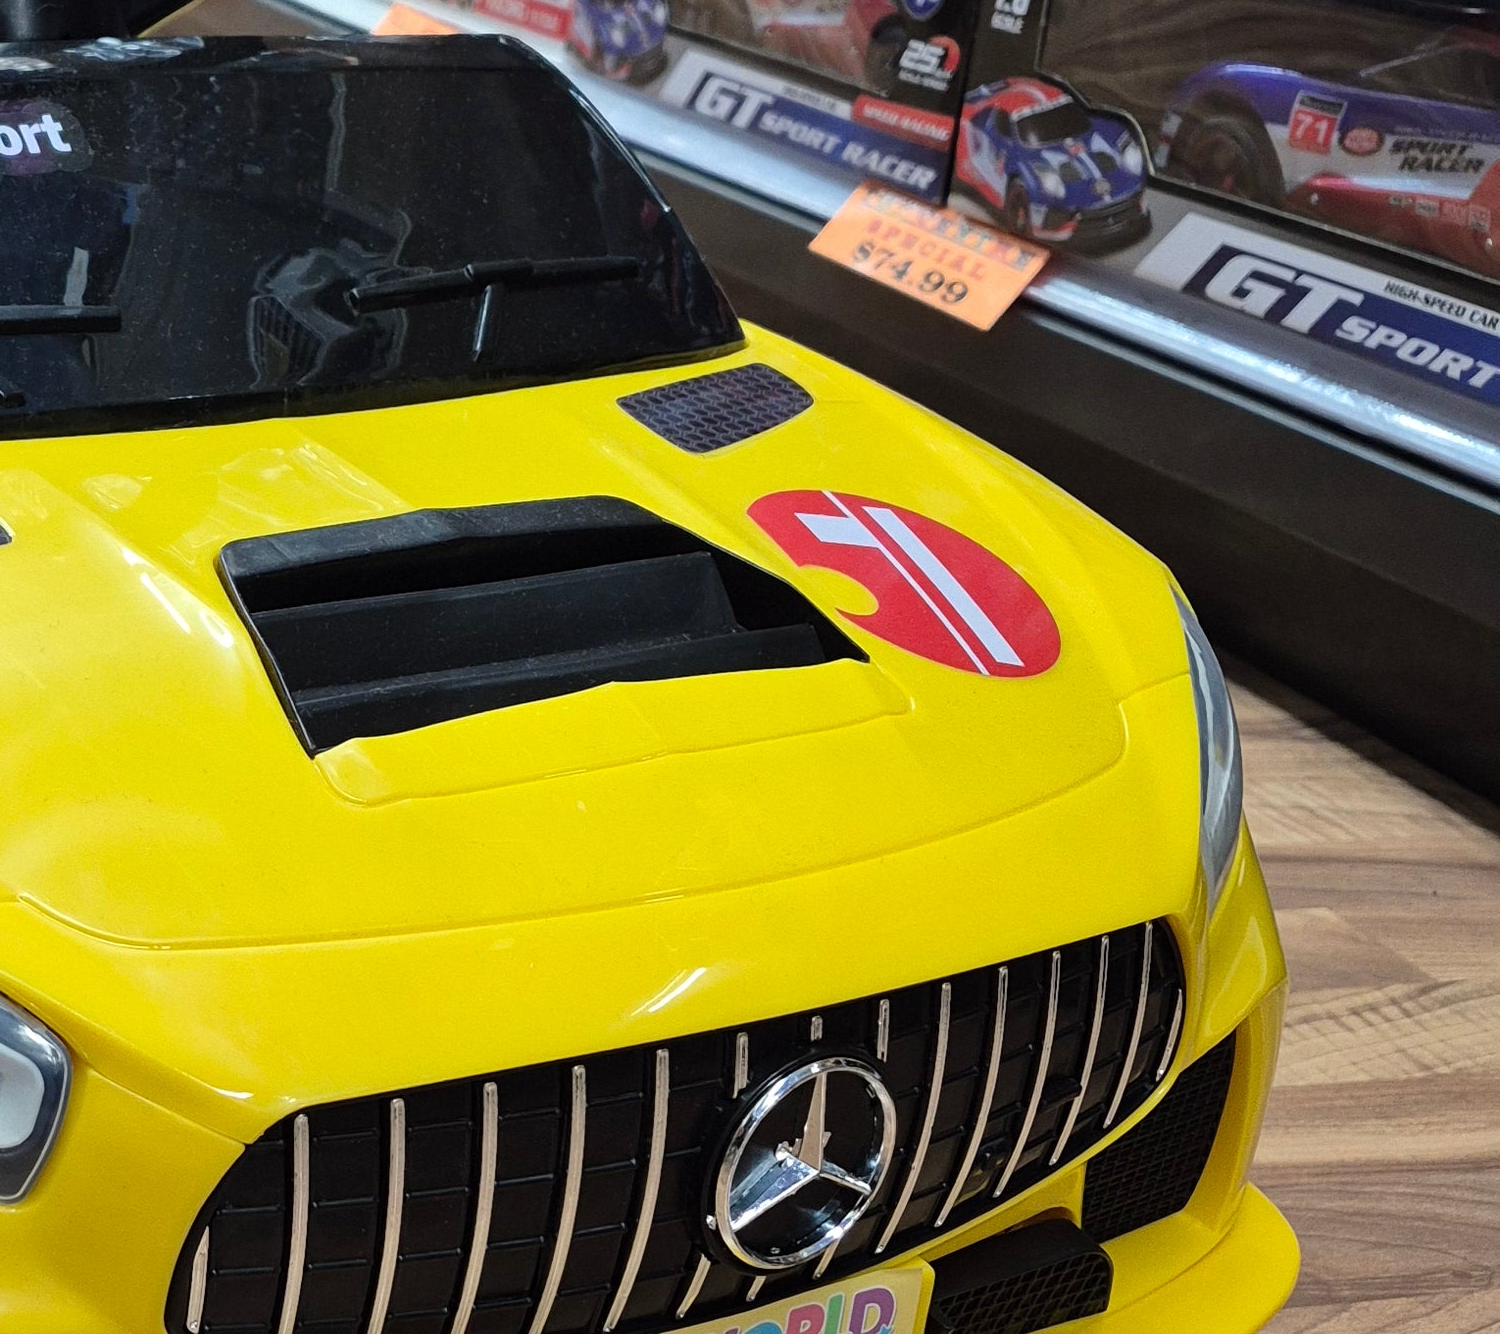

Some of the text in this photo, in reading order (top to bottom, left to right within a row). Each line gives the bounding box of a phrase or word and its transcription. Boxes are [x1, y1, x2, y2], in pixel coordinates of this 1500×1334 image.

[695, 74, 775, 129] GT
[762, 110, 842, 155] SPORT
[843, 141, 938, 190] RACER
[1297, 113, 1329, 142] 71
[852, 240, 969, 304] $74.99
[1384, 280, 1467, 318] HIGH-SPEED
[1204, 254, 1500, 389] GT SPORT
